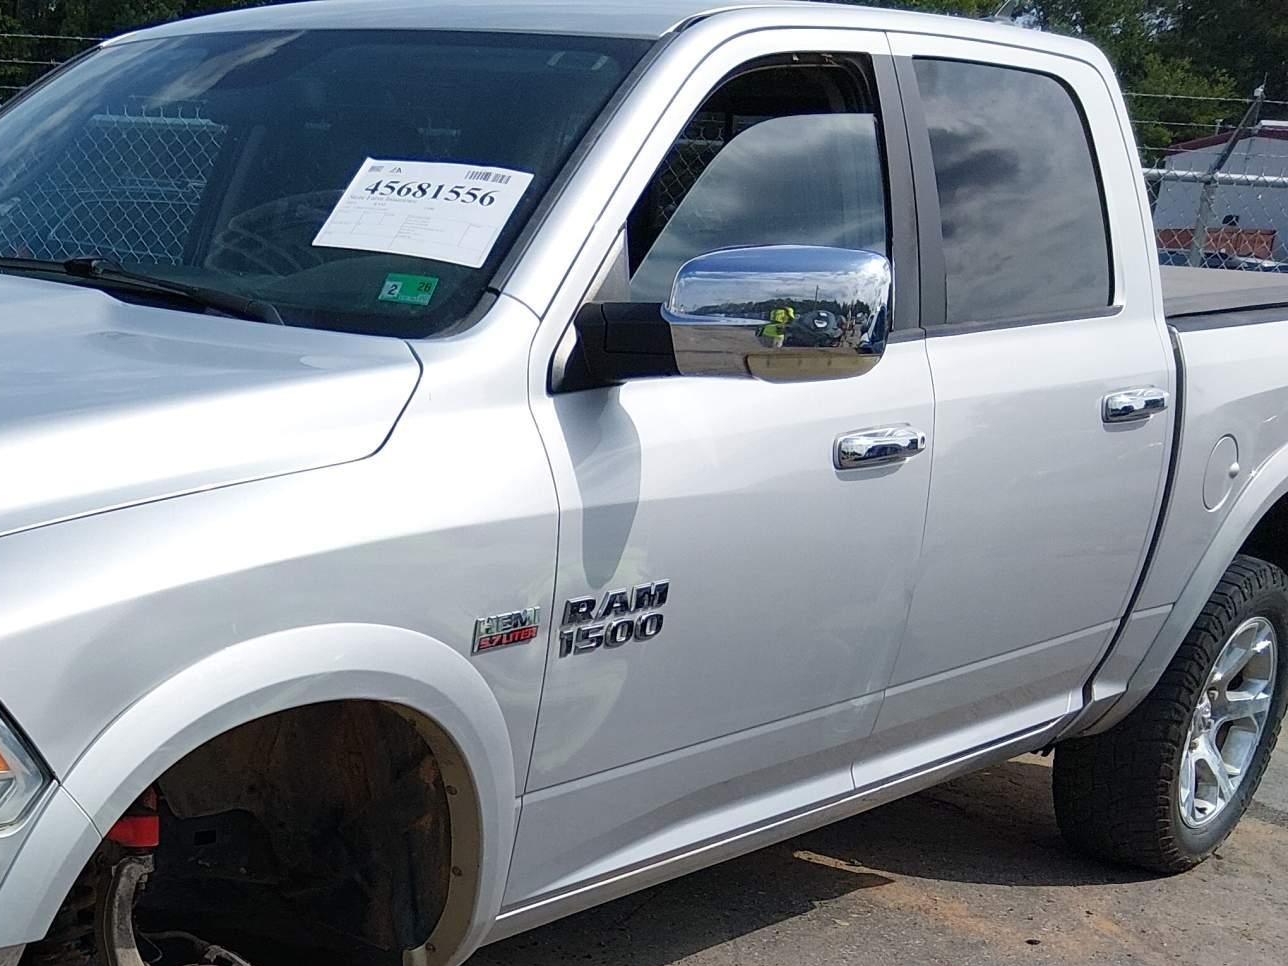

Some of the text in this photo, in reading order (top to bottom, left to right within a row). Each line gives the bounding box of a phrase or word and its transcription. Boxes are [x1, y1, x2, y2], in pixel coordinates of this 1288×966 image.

[364, 179, 500, 207] 45681556
[387, 283, 398, 296] 2
[560, 579, 670, 626] RAM
[473, 606, 541, 640] HEMI
[478, 626, 537, 649] 5.7 LITER
[558, 612, 664, 658] 1500
